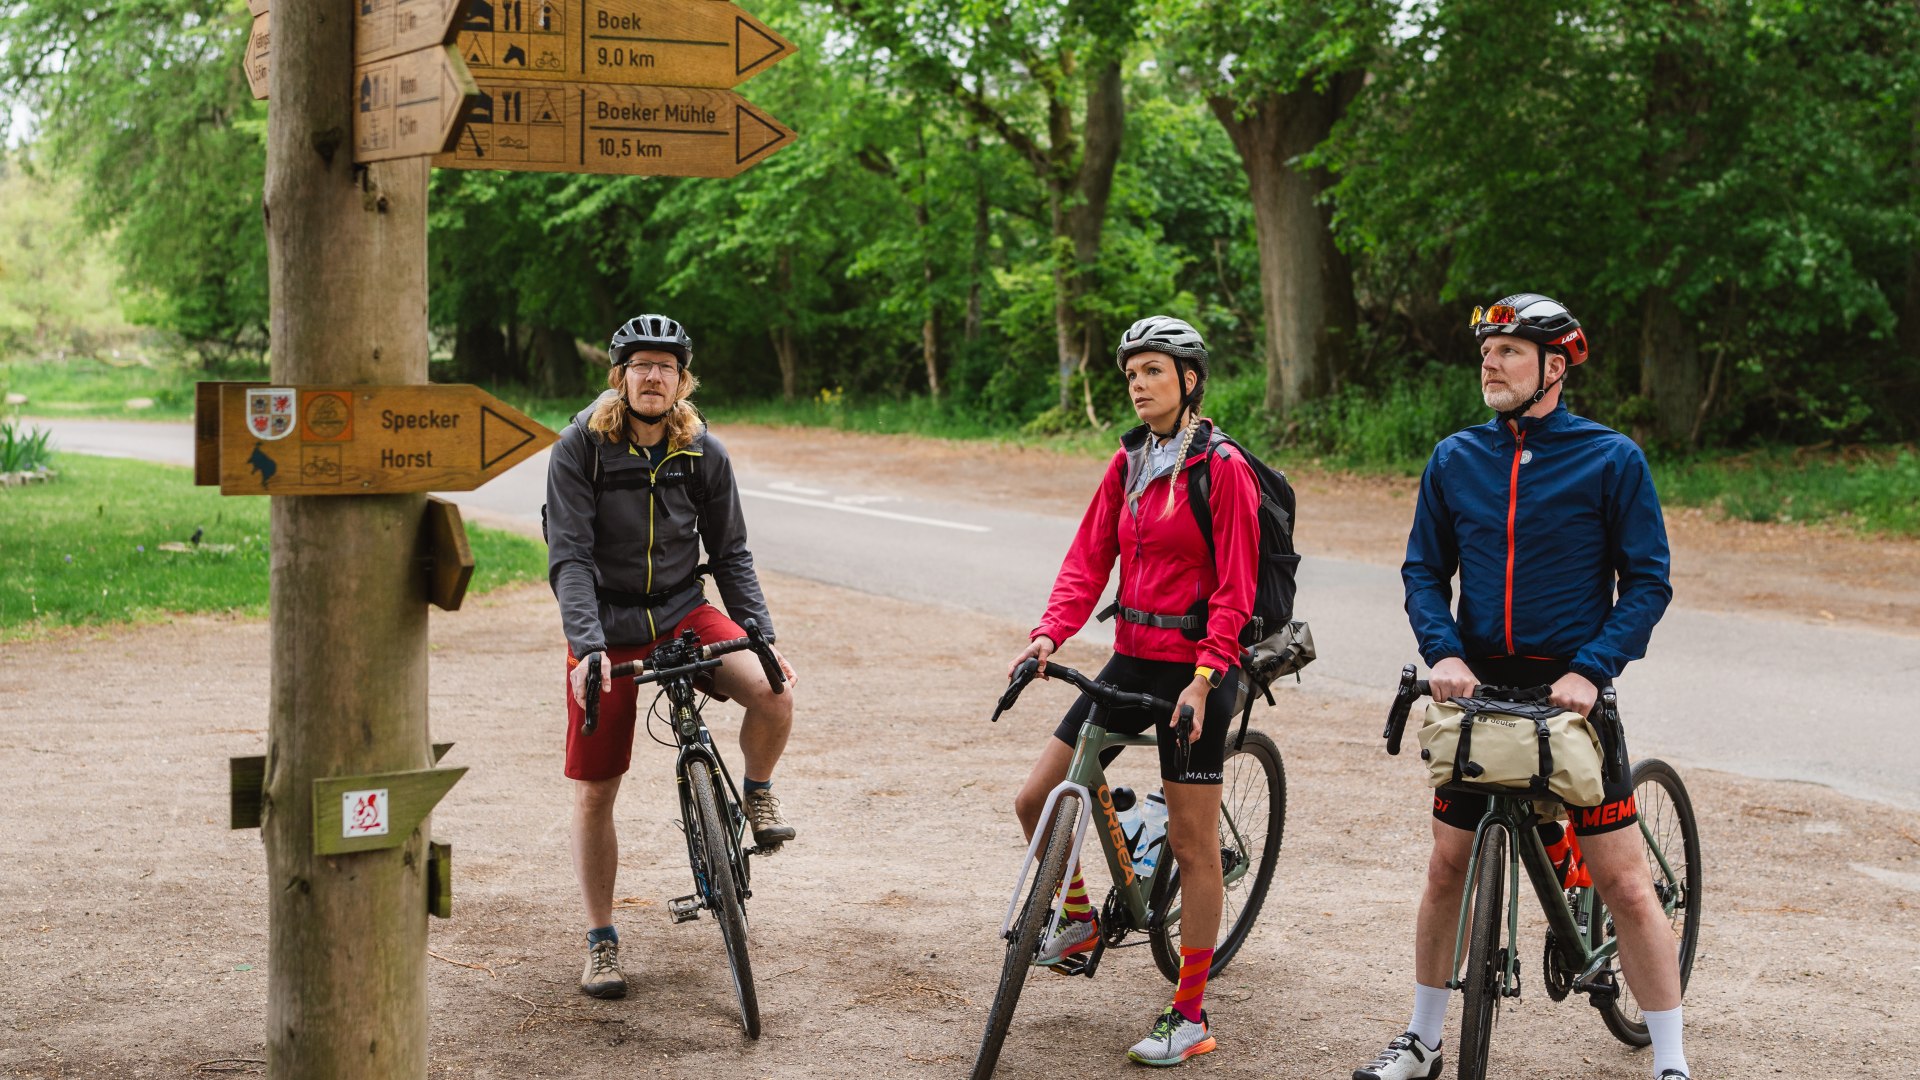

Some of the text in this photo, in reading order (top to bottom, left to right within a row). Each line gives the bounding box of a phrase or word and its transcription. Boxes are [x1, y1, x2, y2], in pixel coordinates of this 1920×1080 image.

[598, 10, 641, 30] Boek
[598, 47, 655, 68] 9,0 km
[597, 100, 716, 124] Boeker Mühle
[597, 137, 663, 159] 10,5 km
[381, 409, 460, 434] Specker
[381, 448, 433, 469] Horst
[1097, 784, 1135, 887] ORBEA
